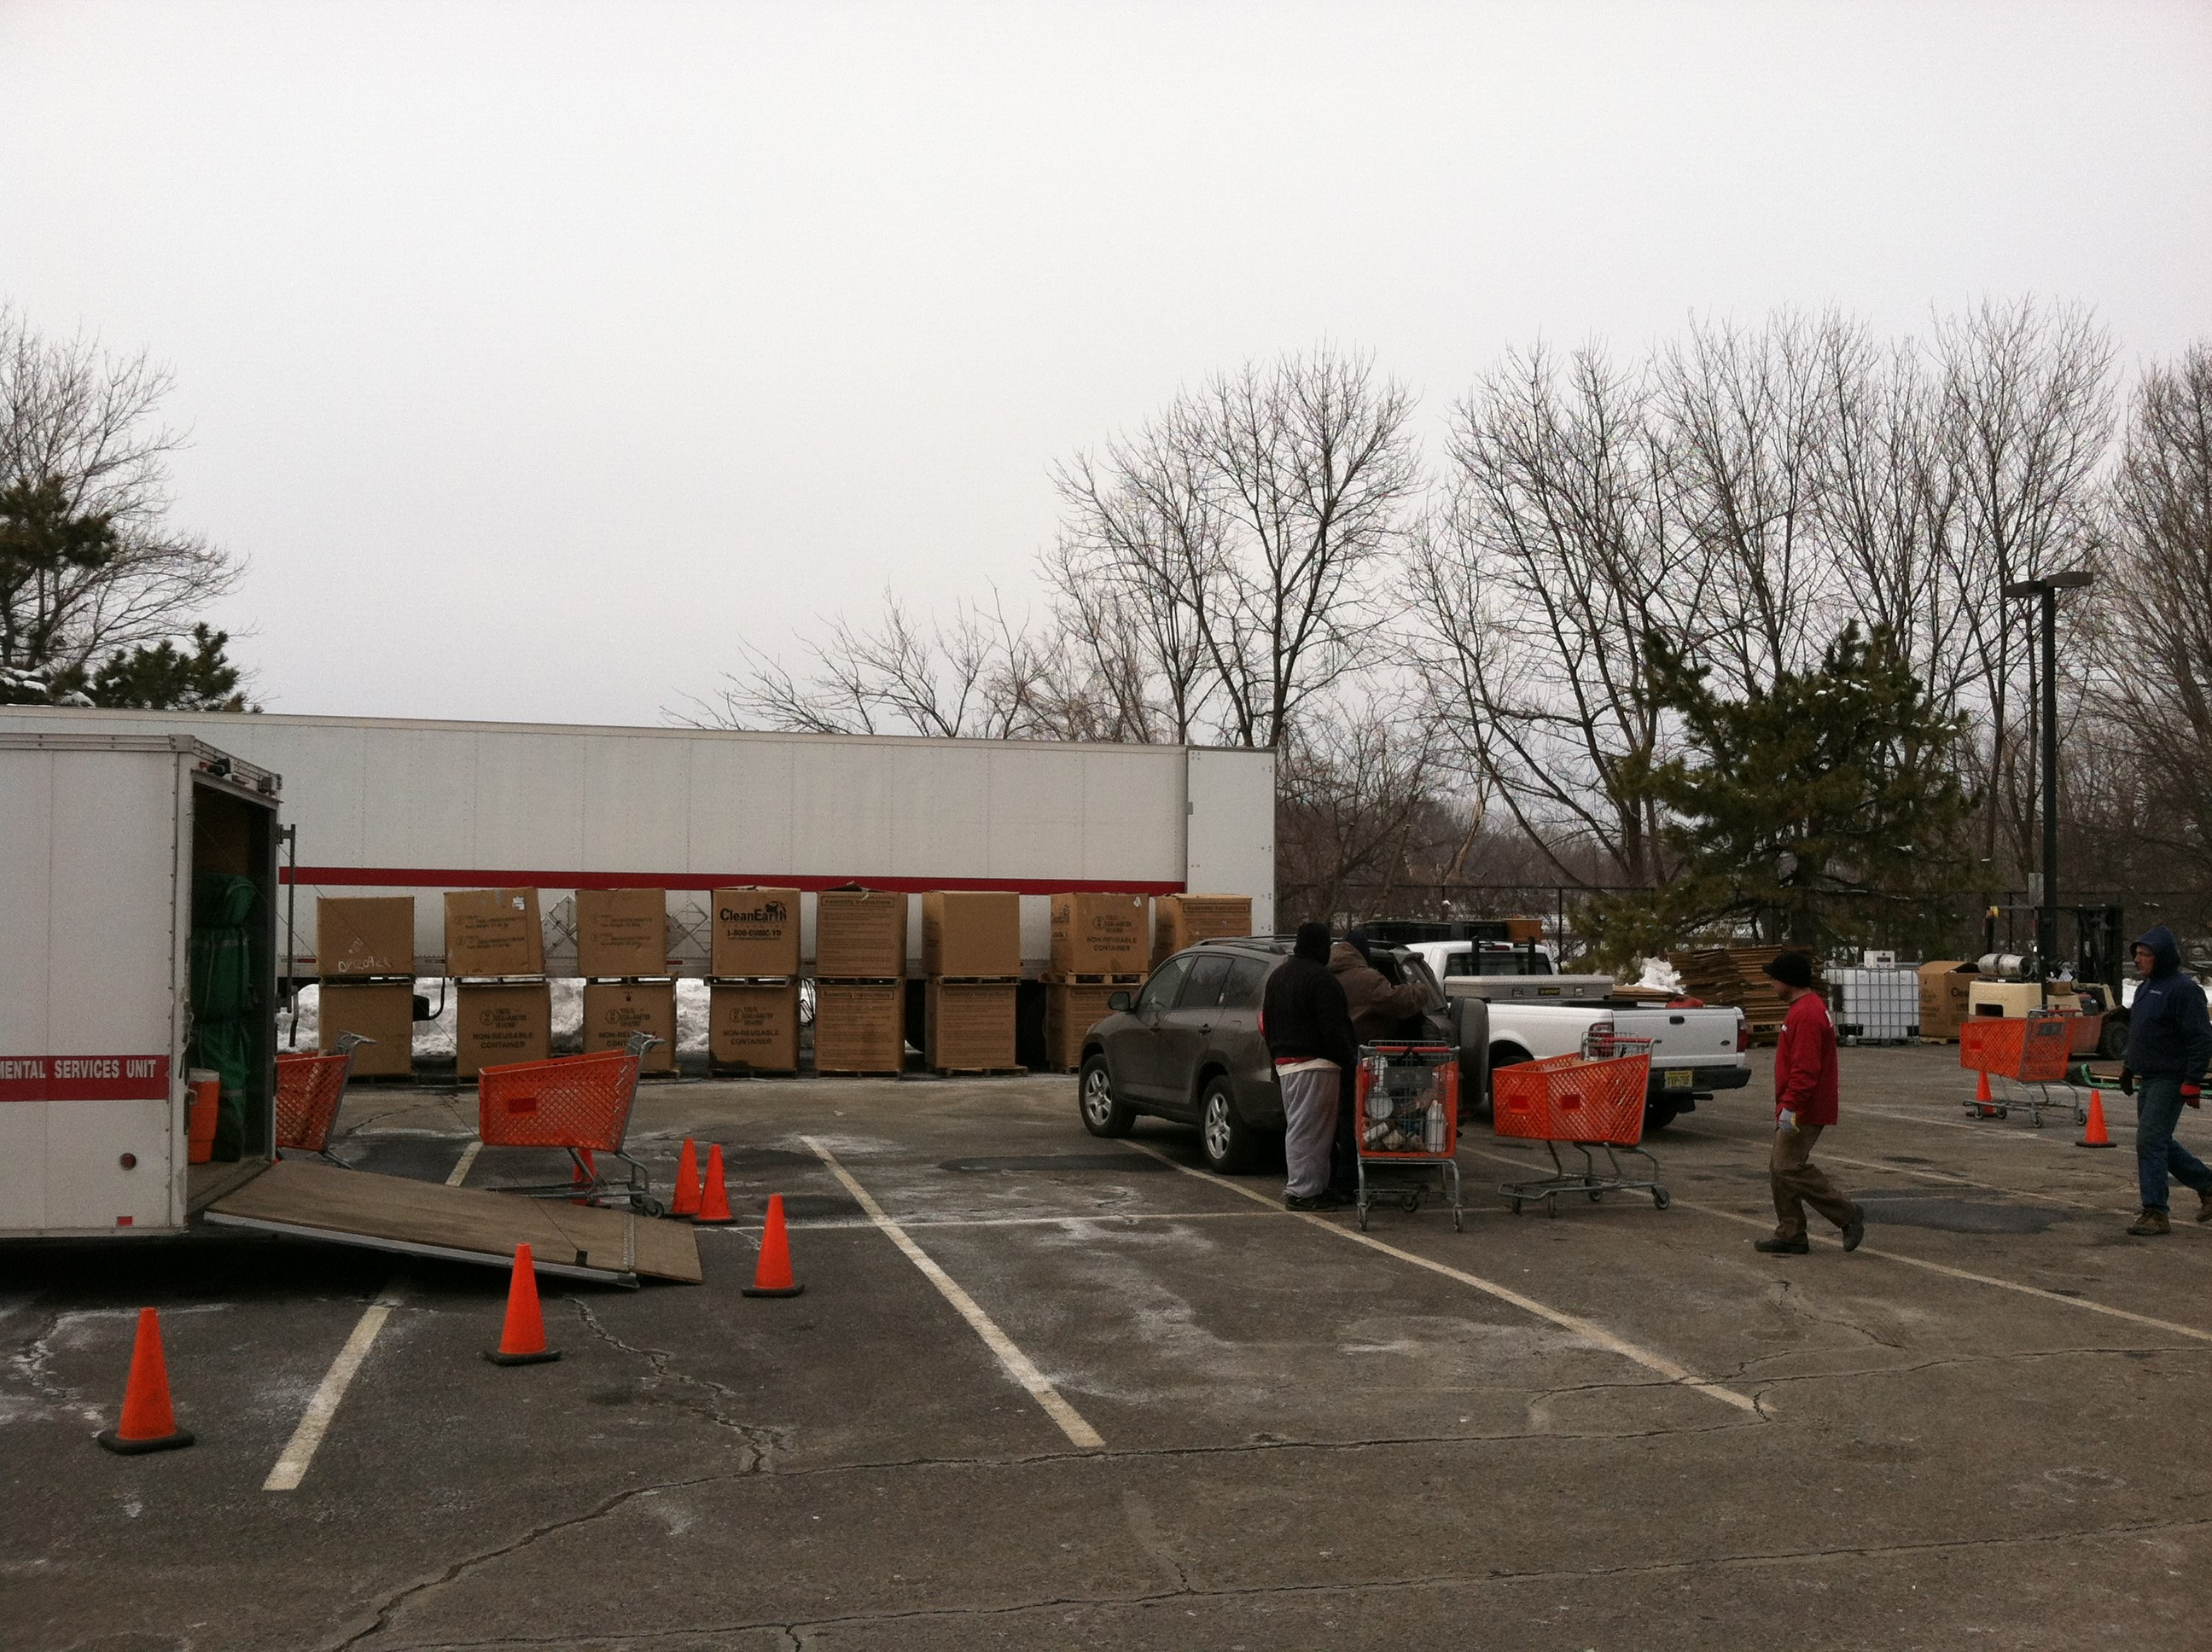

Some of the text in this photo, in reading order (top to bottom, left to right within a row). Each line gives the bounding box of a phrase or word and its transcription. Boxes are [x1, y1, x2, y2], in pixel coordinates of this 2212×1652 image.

[719, 908, 787, 921] CleanEarth
[473, 1032, 533, 1040] NON-REUSABLE
[480, 1040, 526, 1049] CONTAINER
[54, 1059, 119, 1079] SERVICES
[126, 1059, 156, 1079] UNIT
